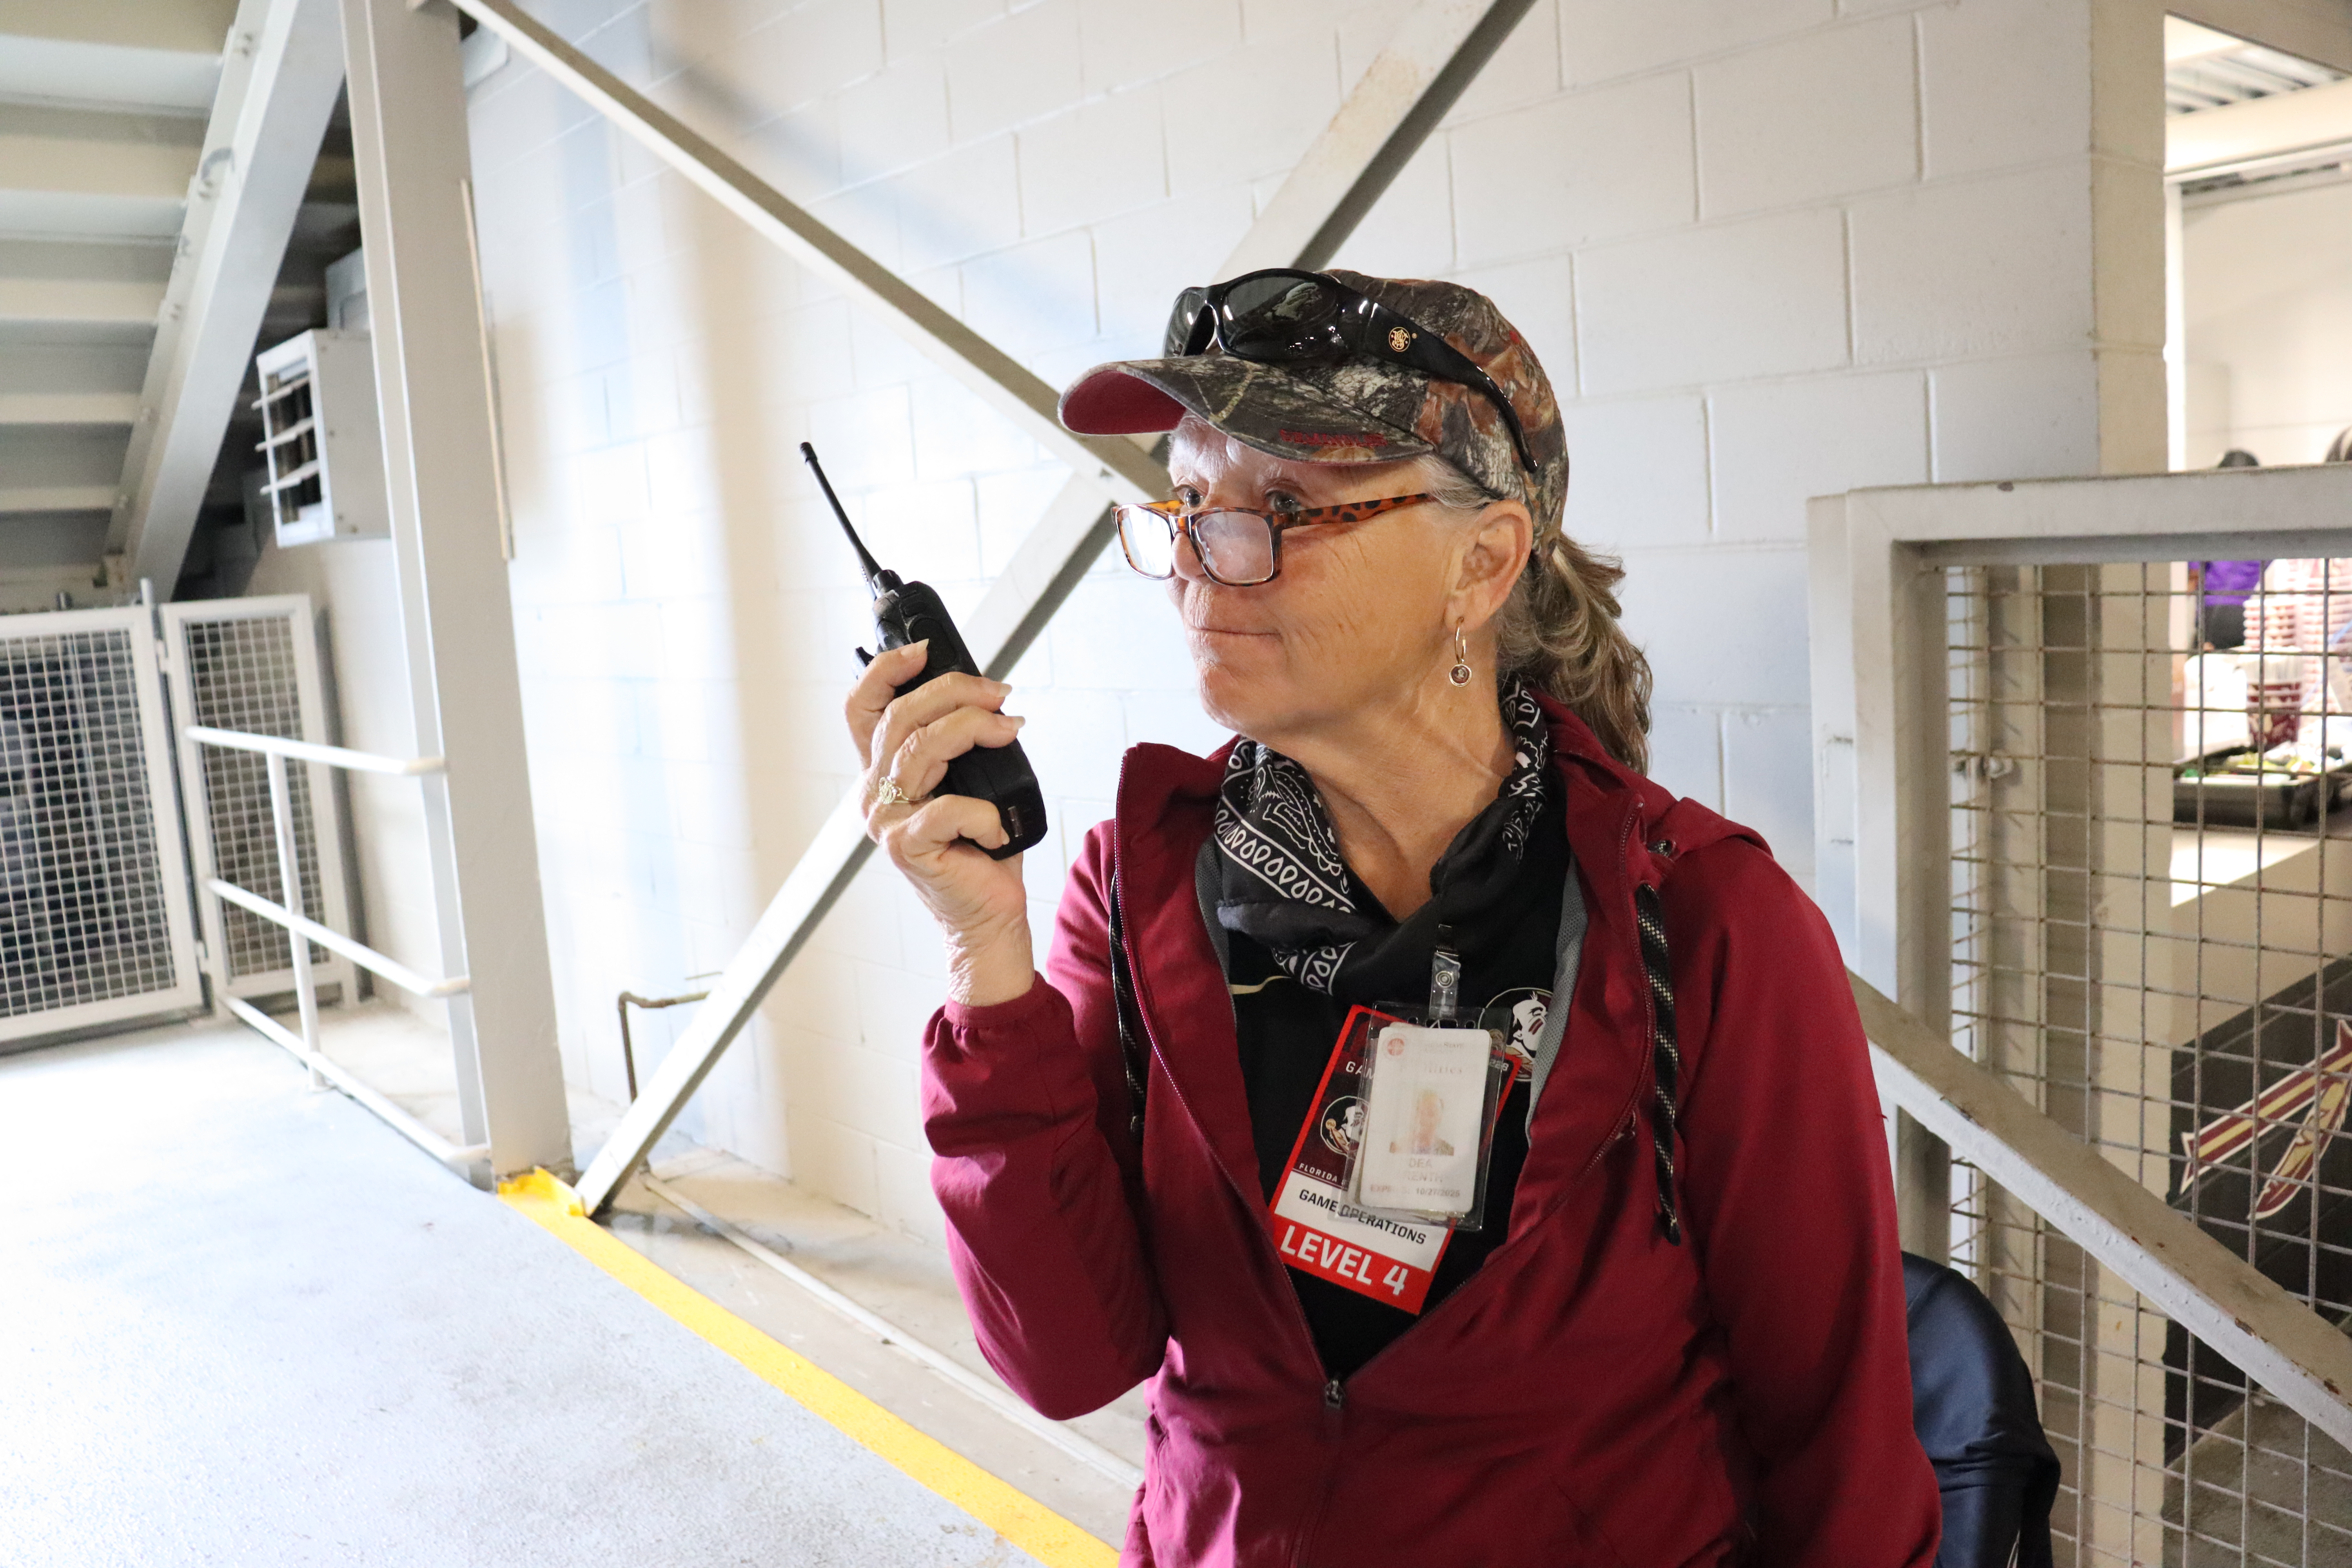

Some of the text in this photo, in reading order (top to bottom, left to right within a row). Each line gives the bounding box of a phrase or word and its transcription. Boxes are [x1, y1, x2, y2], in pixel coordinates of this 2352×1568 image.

[1299, 1163, 1338, 1183] FLORIDA
[1299, 1189, 1426, 1244] GAME OPERATIONS
[1280, 1225, 1408, 1296] LEVEL 4
